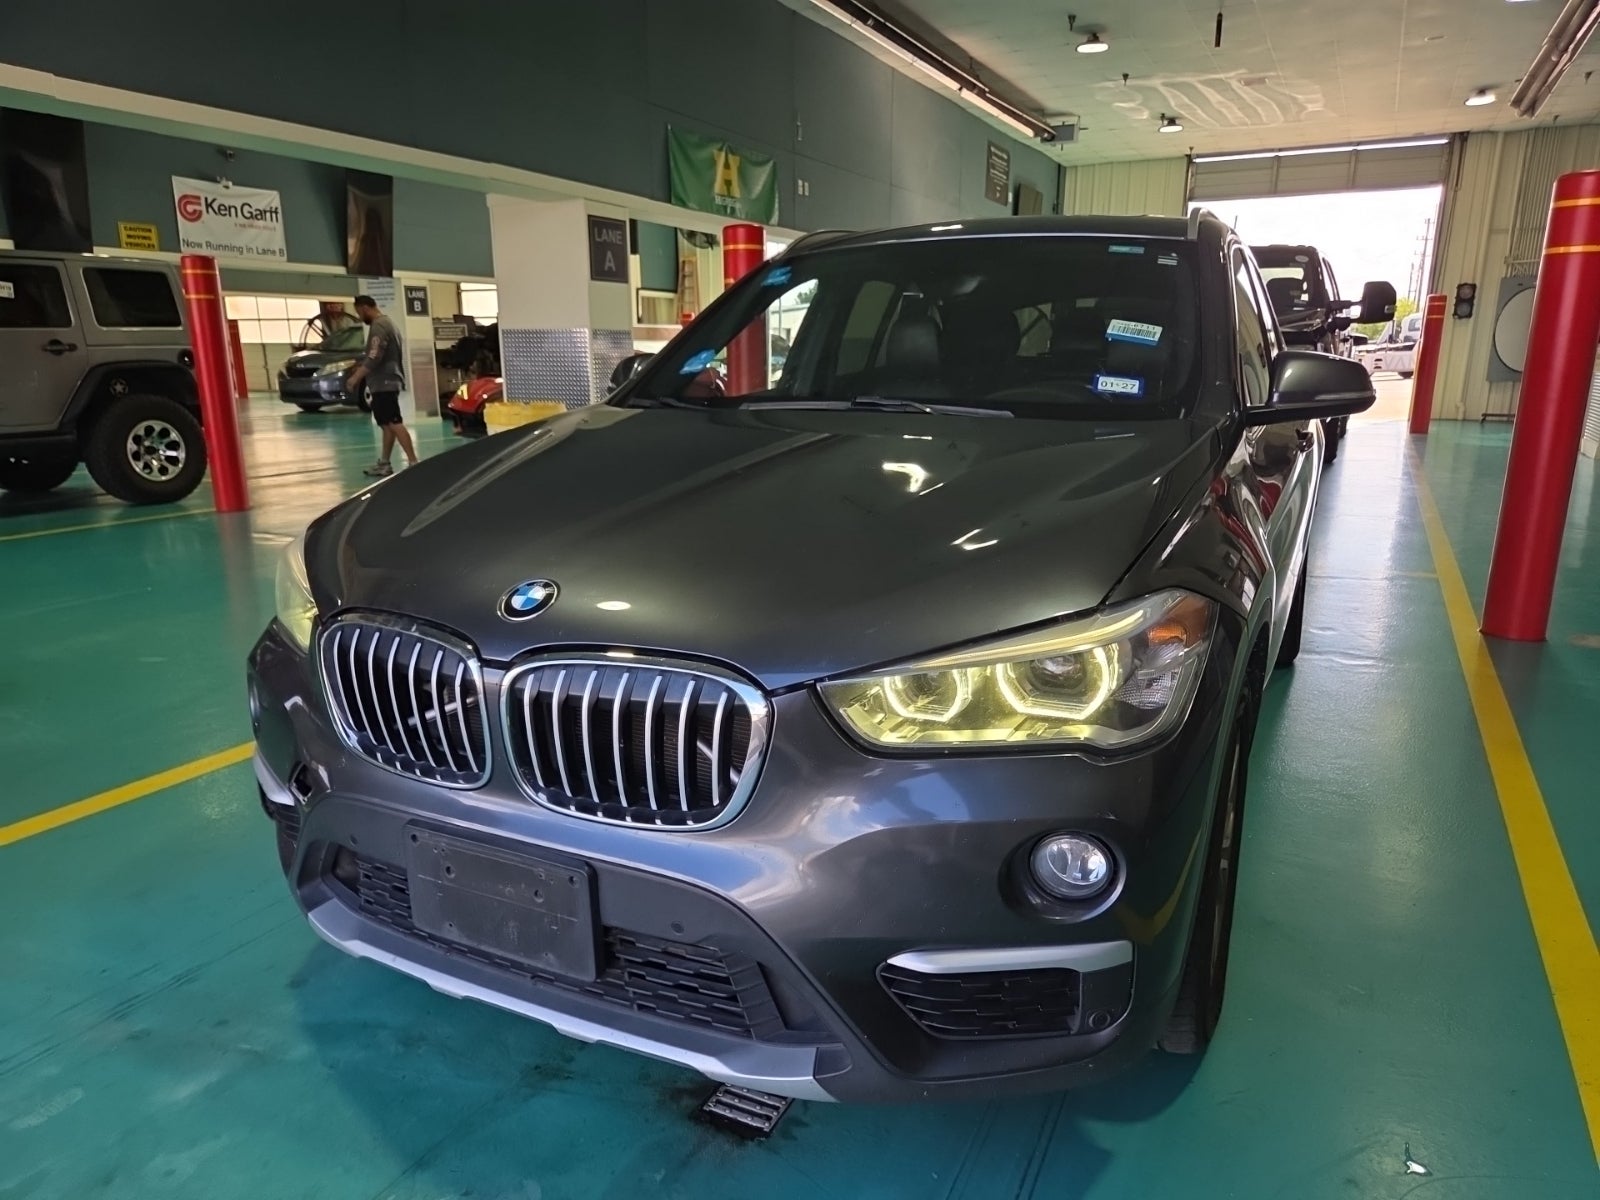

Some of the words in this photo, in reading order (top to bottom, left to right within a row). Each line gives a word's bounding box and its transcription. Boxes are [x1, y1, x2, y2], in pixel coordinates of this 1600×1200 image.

[204, 196, 239, 219] Ken
[240, 202, 280, 223] Garff
[594, 226, 623, 245] LANE
[182, 238, 203, 249] Now
[205, 240, 244, 255] Running
[245, 244, 254, 254] in
[256, 246, 276, 257] Lane
[278, 248, 285, 257] B
[604, 250, 617, 272] A
[407, 289, 426, 299] LANE
[413, 300, 422, 312] B
